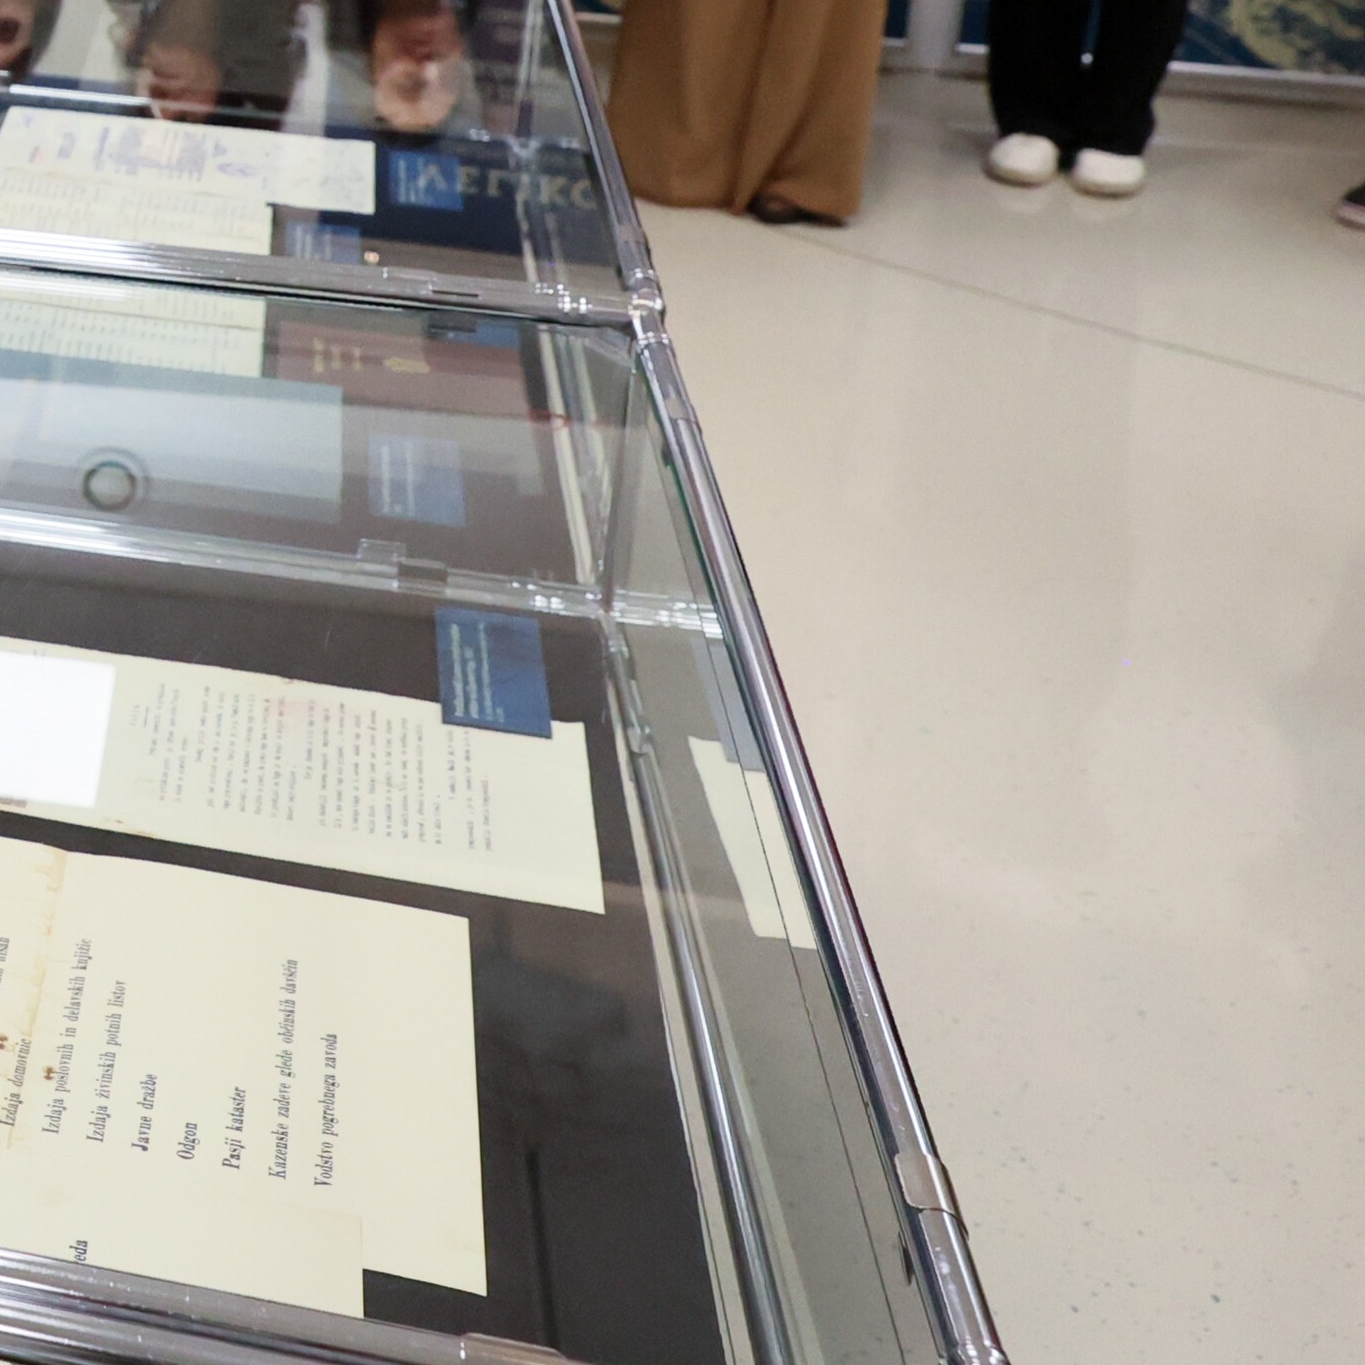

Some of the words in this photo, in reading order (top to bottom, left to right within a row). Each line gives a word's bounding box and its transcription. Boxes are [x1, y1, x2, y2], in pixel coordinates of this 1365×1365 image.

[62, 976, 86, 1022] delavskih
[107, 980, 126, 1008] listov
[64, 1026, 79, 1039] in
[105, 1013, 122, 1047] potnih
[276, 999, 296, 1044] občinskih
[6, 1038, 32, 1088] domovnic
[274, 1049, 296, 1078] glede
[319, 1033, 338, 1070] zavoda
[94, 1051, 117, 1100] živinskih
[136, 1073, 158, 1111] dražbe
[41, 1098, 68, 1135] Izdaja
[224, 1086, 247, 1133] kataster
[272, 1082, 292, 1119] zadeve
[317, 1073, 341, 1138] pogrebnega
[85, 1105, 112, 1143] Izdaja
[130, 1115, 153, 1152] Javne
[175, 1122, 201, 1161] Odgon
[221, 1137, 246, 1171] Pasji
[267, 1122, 289, 1181] Kazenske
[313, 1141, 334, 1186] Vodstvo
